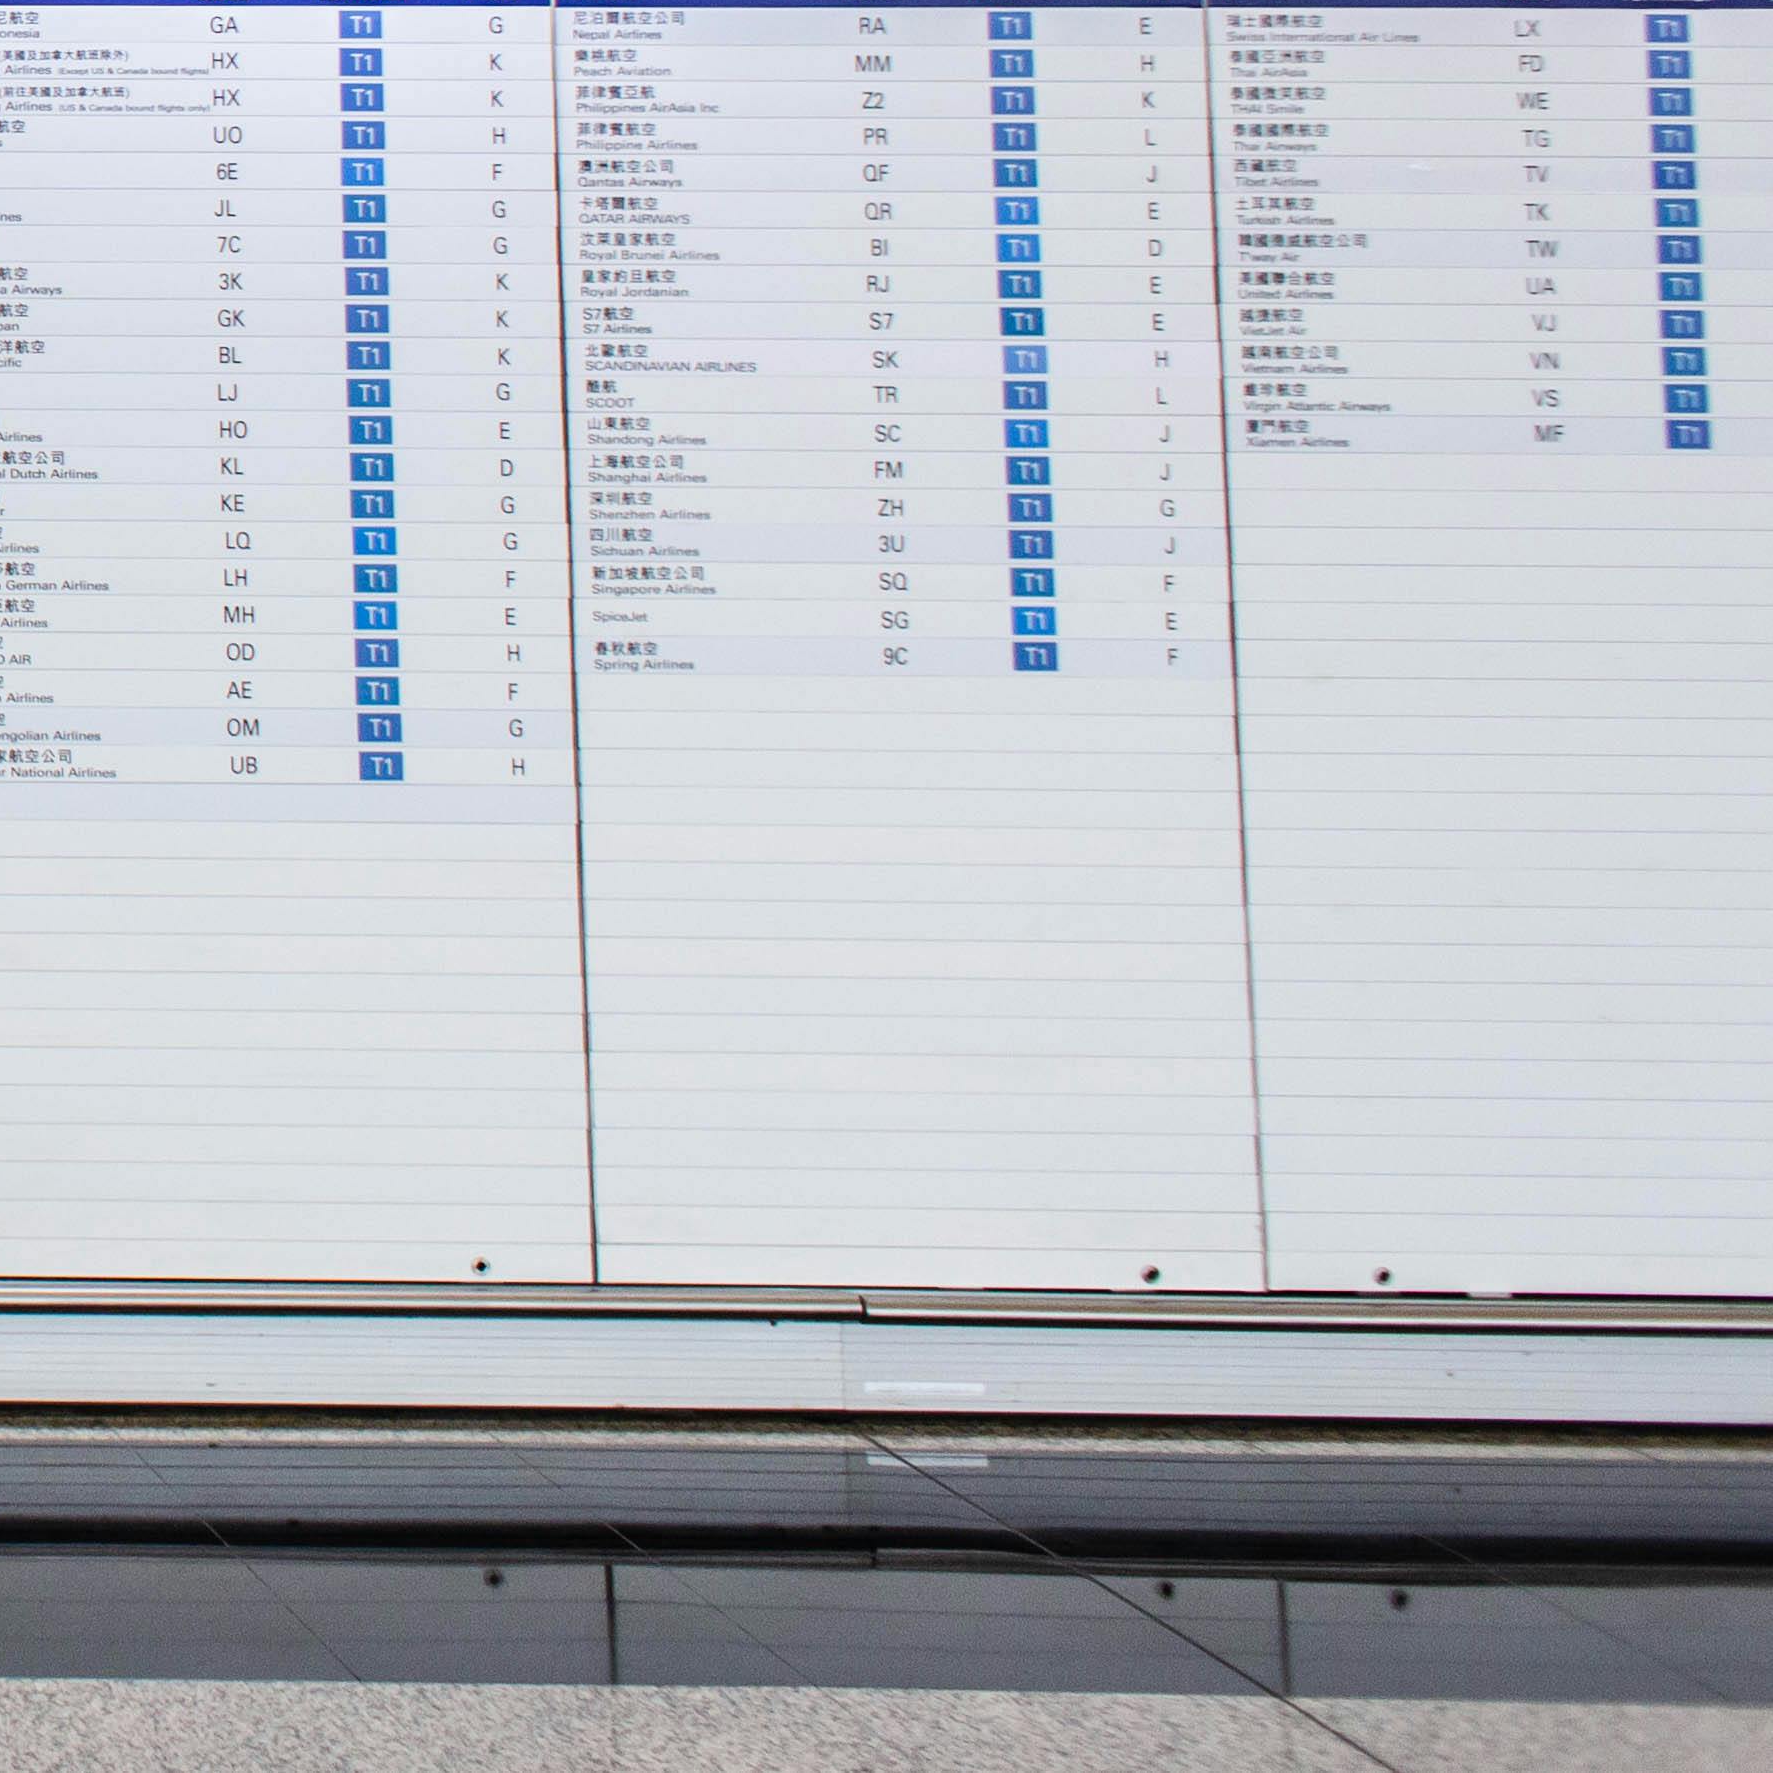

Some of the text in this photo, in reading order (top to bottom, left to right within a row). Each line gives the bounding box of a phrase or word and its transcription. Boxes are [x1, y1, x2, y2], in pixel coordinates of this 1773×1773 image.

[1521, 129, 1551, 148] TG
[216, 162, 239, 181] 6E
[351, 162, 375, 181] T1
[492, 163, 503, 181] F
[869, 311, 895, 331] S7
[1011, 312, 1036, 331] T1
[1152, 313, 1165, 332] E
[219, 420, 248, 439] HO
[359, 420, 383, 440] T1
[499, 421, 511, 440] E
[593, 658, 695, 673] Spring Airlines
[10, 766, 65, 778] National
[67, 766, 118, 779] Airlines
